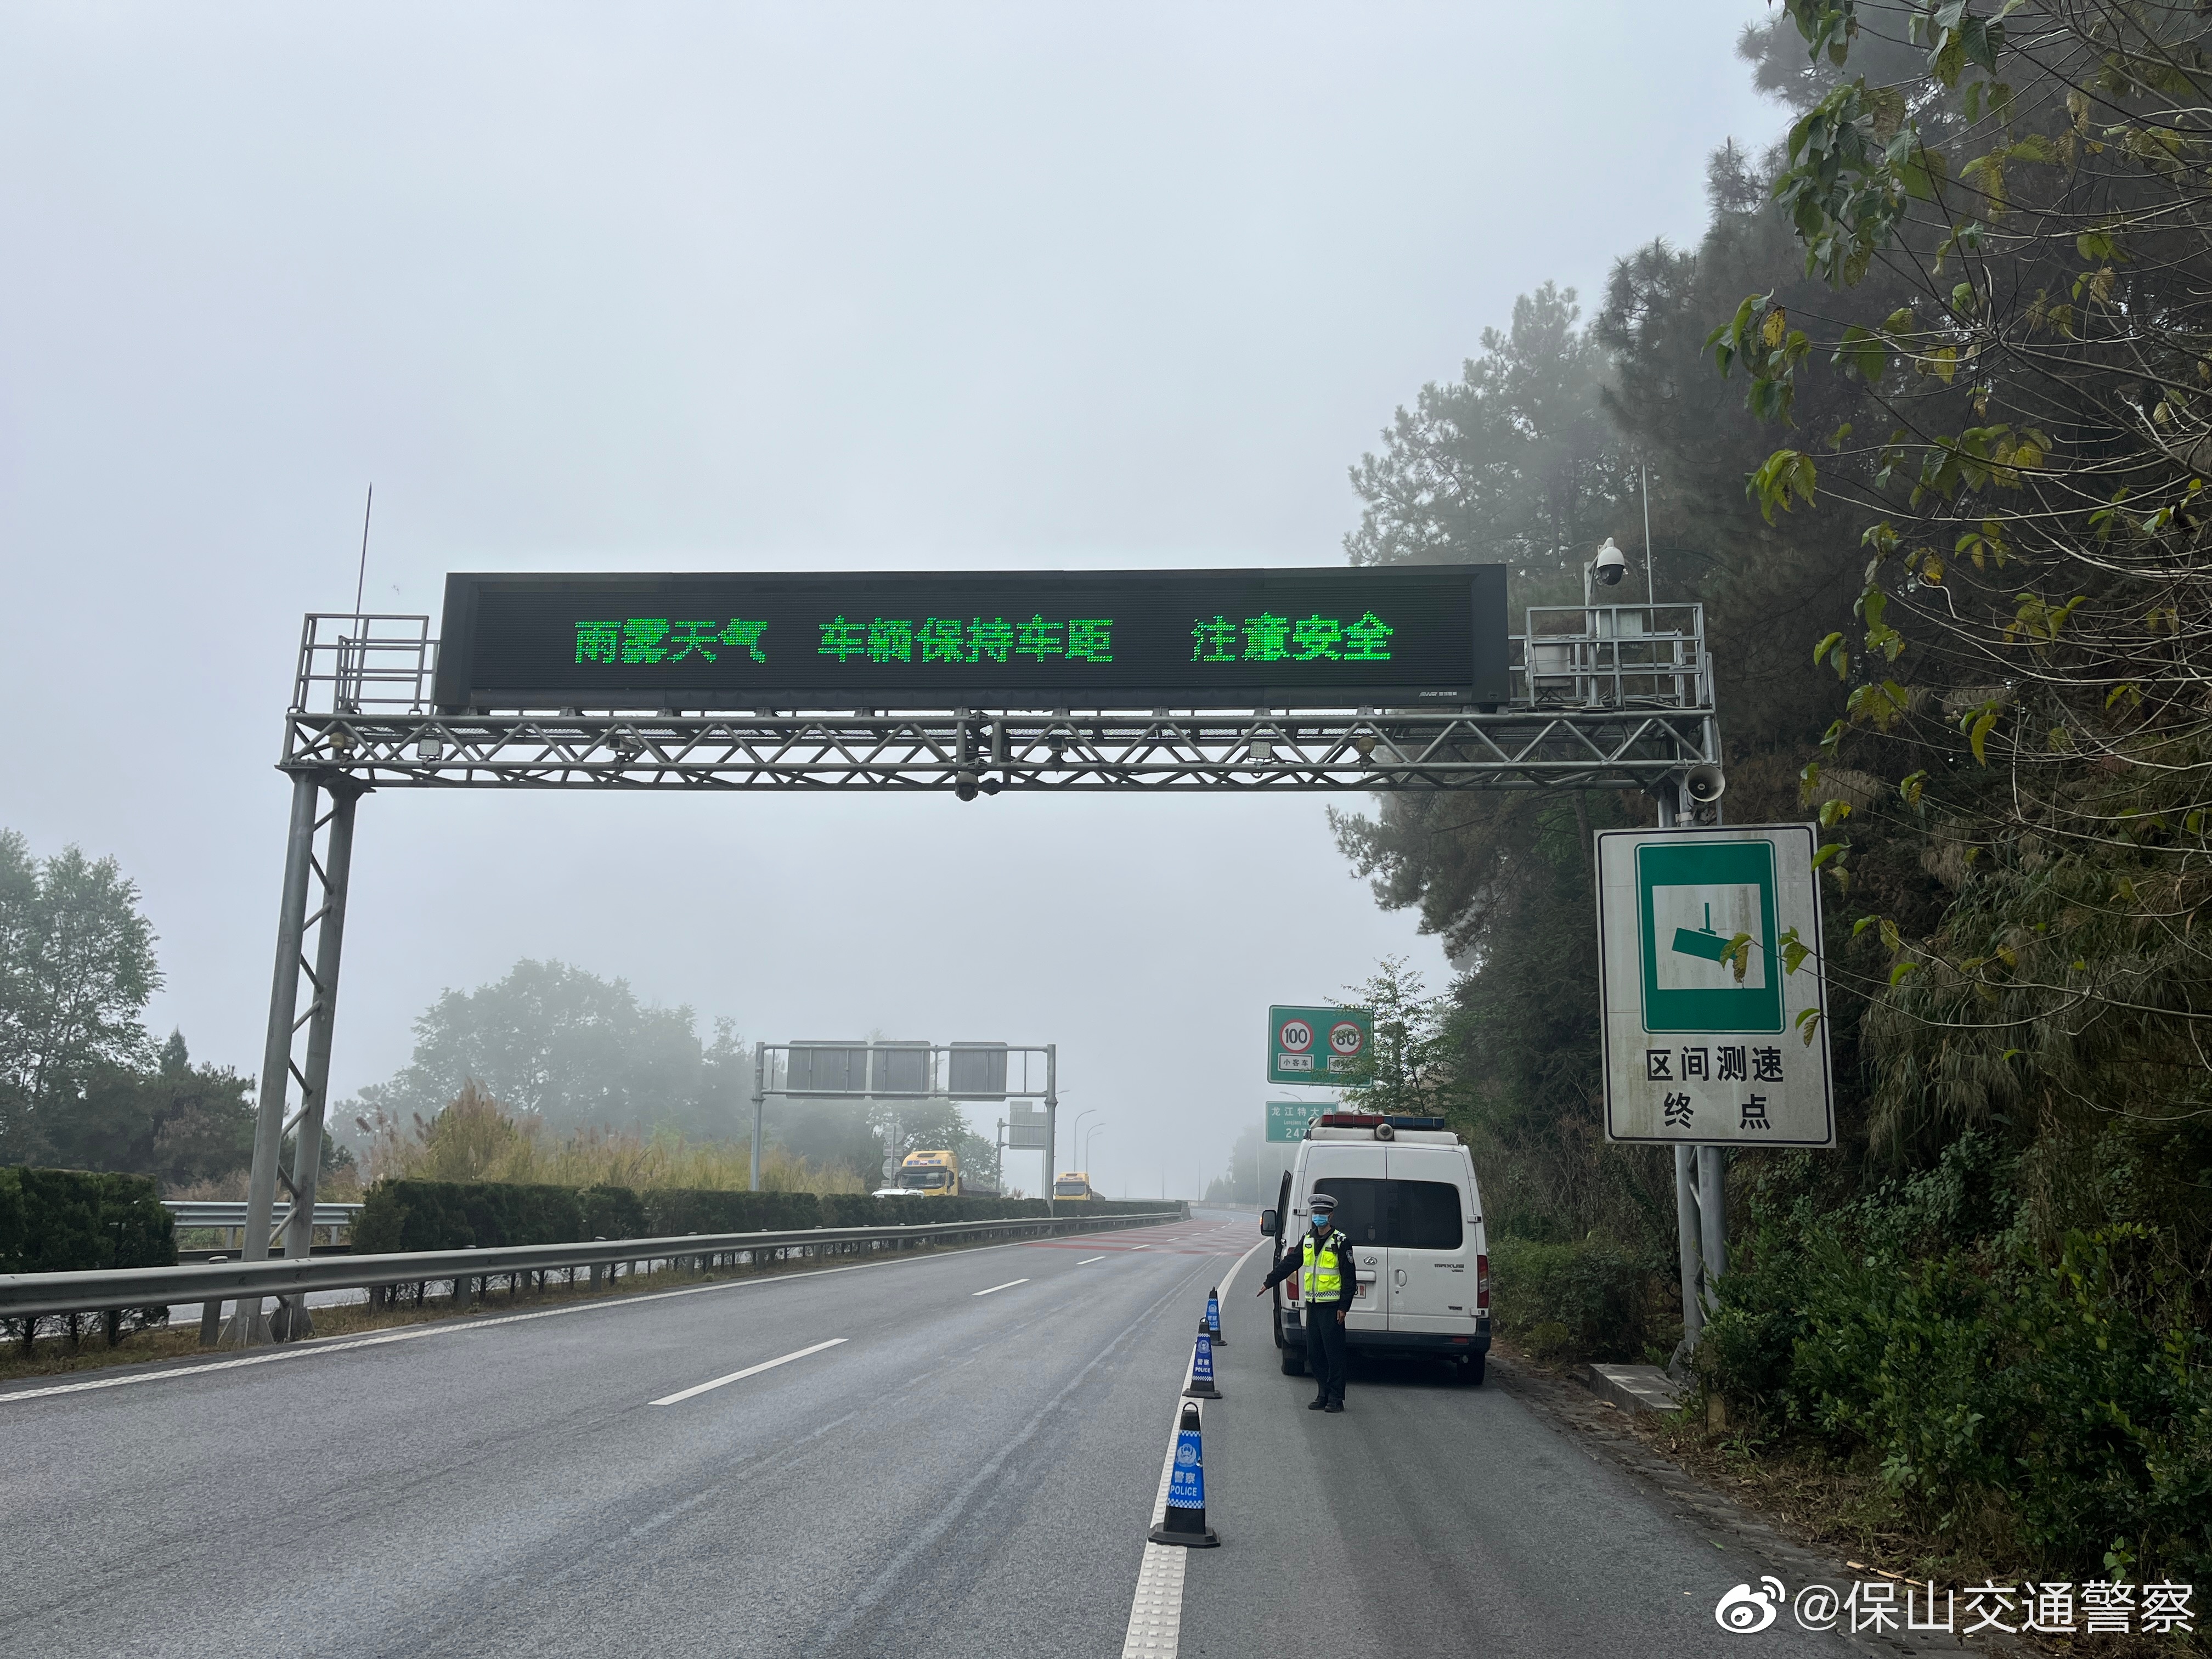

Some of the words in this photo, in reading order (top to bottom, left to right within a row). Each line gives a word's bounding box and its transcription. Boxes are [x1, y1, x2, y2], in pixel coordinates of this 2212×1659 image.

[817, 614, 1114, 663] 车辆保持车距
[1190, 611, 1394, 662] 注意安全
[1285, 1028, 1307, 1044] 100
[1283, 1059, 1309, 1067] 小客车
[1646, 1046, 1784, 1082] 区间测速
[1271, 1107, 1333, 1116] 龙江特大桥
[1663, 1092, 1771, 1130] 终点
[1175, 1471, 1195, 1484] 警察
[1170, 1485, 1197, 1497] POLICE
